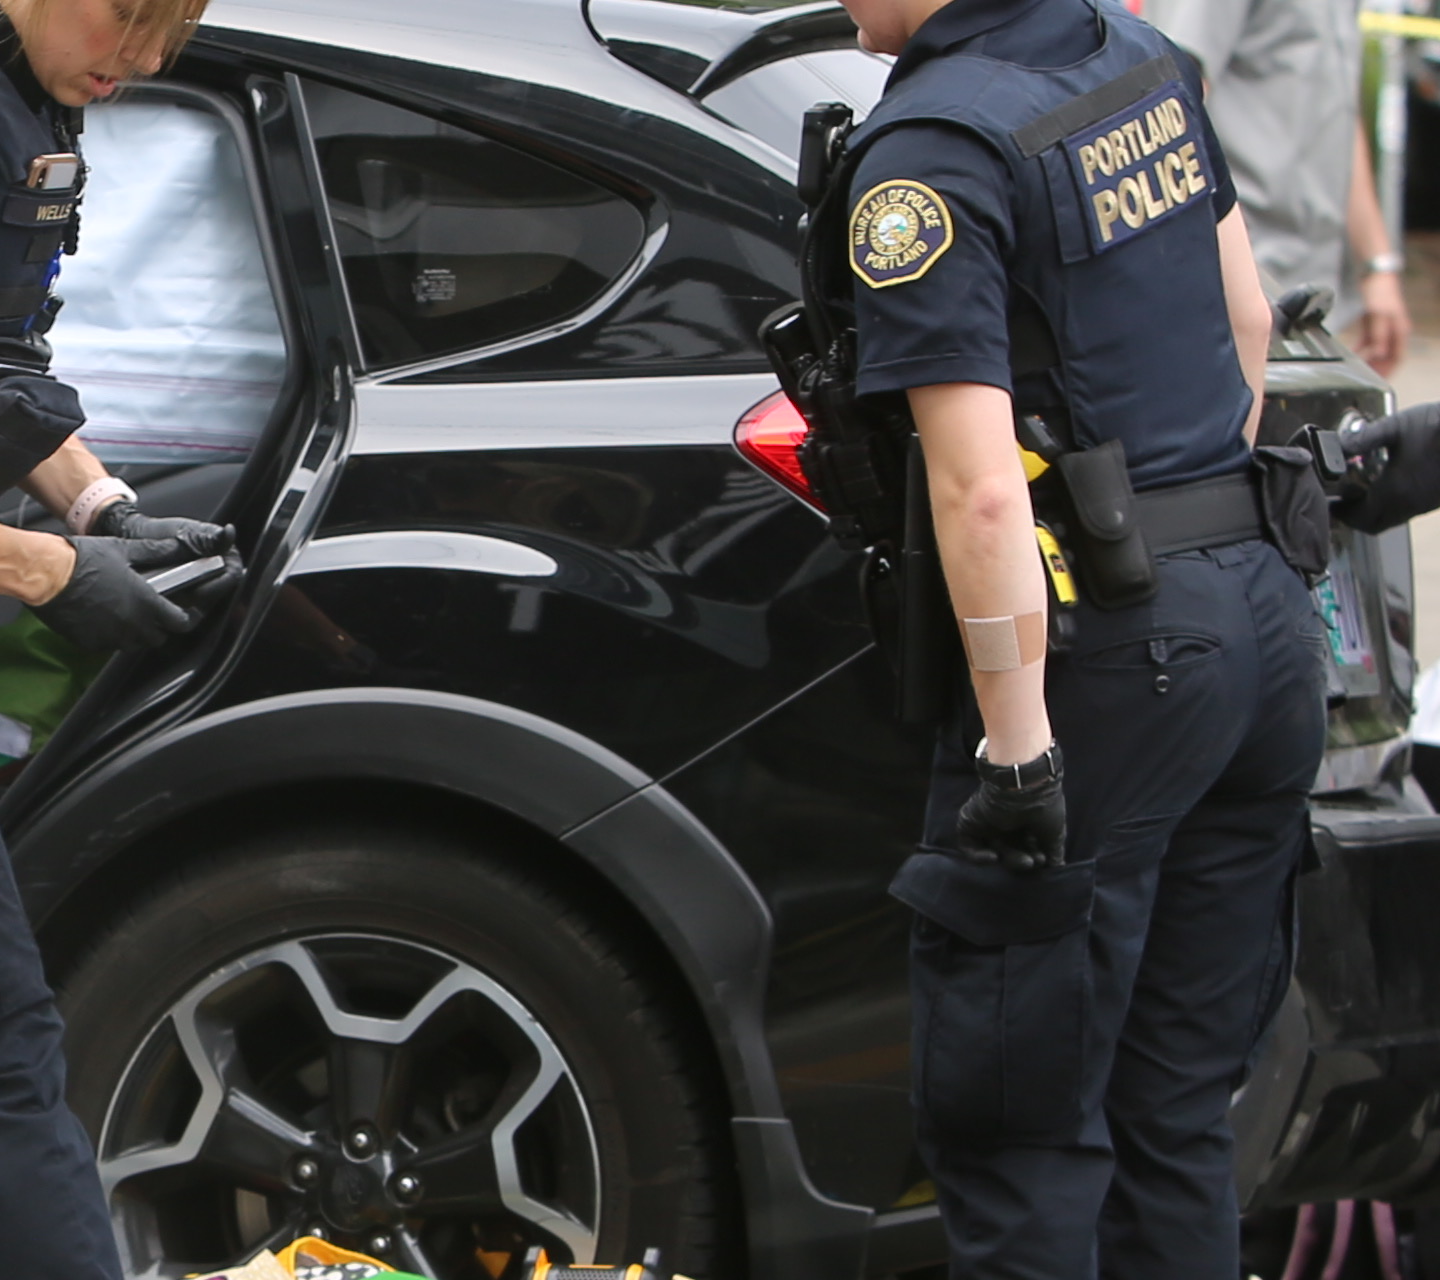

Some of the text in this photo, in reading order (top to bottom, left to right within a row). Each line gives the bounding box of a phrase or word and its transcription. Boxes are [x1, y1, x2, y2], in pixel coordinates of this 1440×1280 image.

[1077, 96, 1187, 186] PORTLAND
[36, 203, 73, 221] WELLS
[887, 189, 907, 203] OF
[903, 190, 941, 230] POLICE
[1092, 141, 1207, 243] POLICE
[864, 240, 930, 270] PORTLAND
